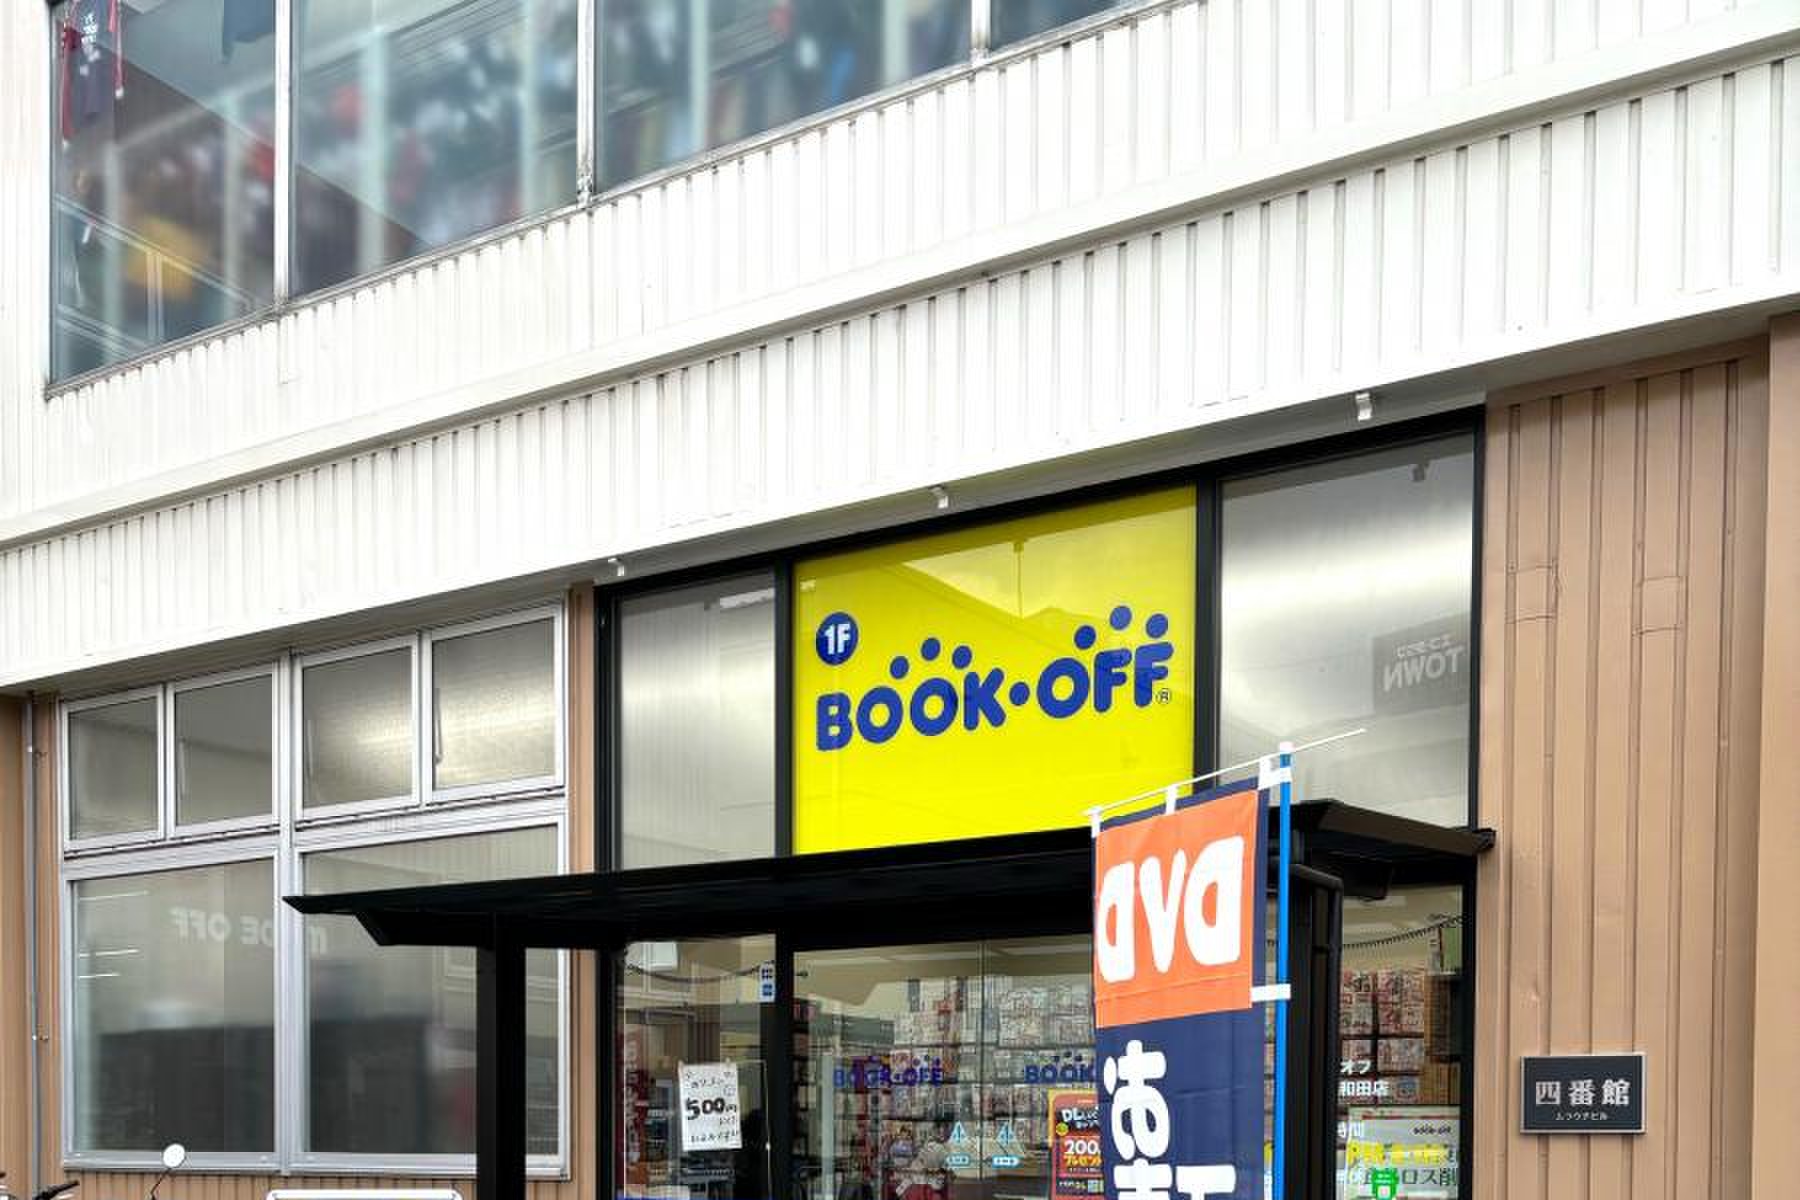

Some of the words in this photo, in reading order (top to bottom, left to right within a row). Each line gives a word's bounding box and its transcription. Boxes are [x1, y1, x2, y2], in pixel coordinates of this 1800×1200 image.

[823, 623, 851, 655] 1F
[1535, 1078, 1630, 1107] 四番館
